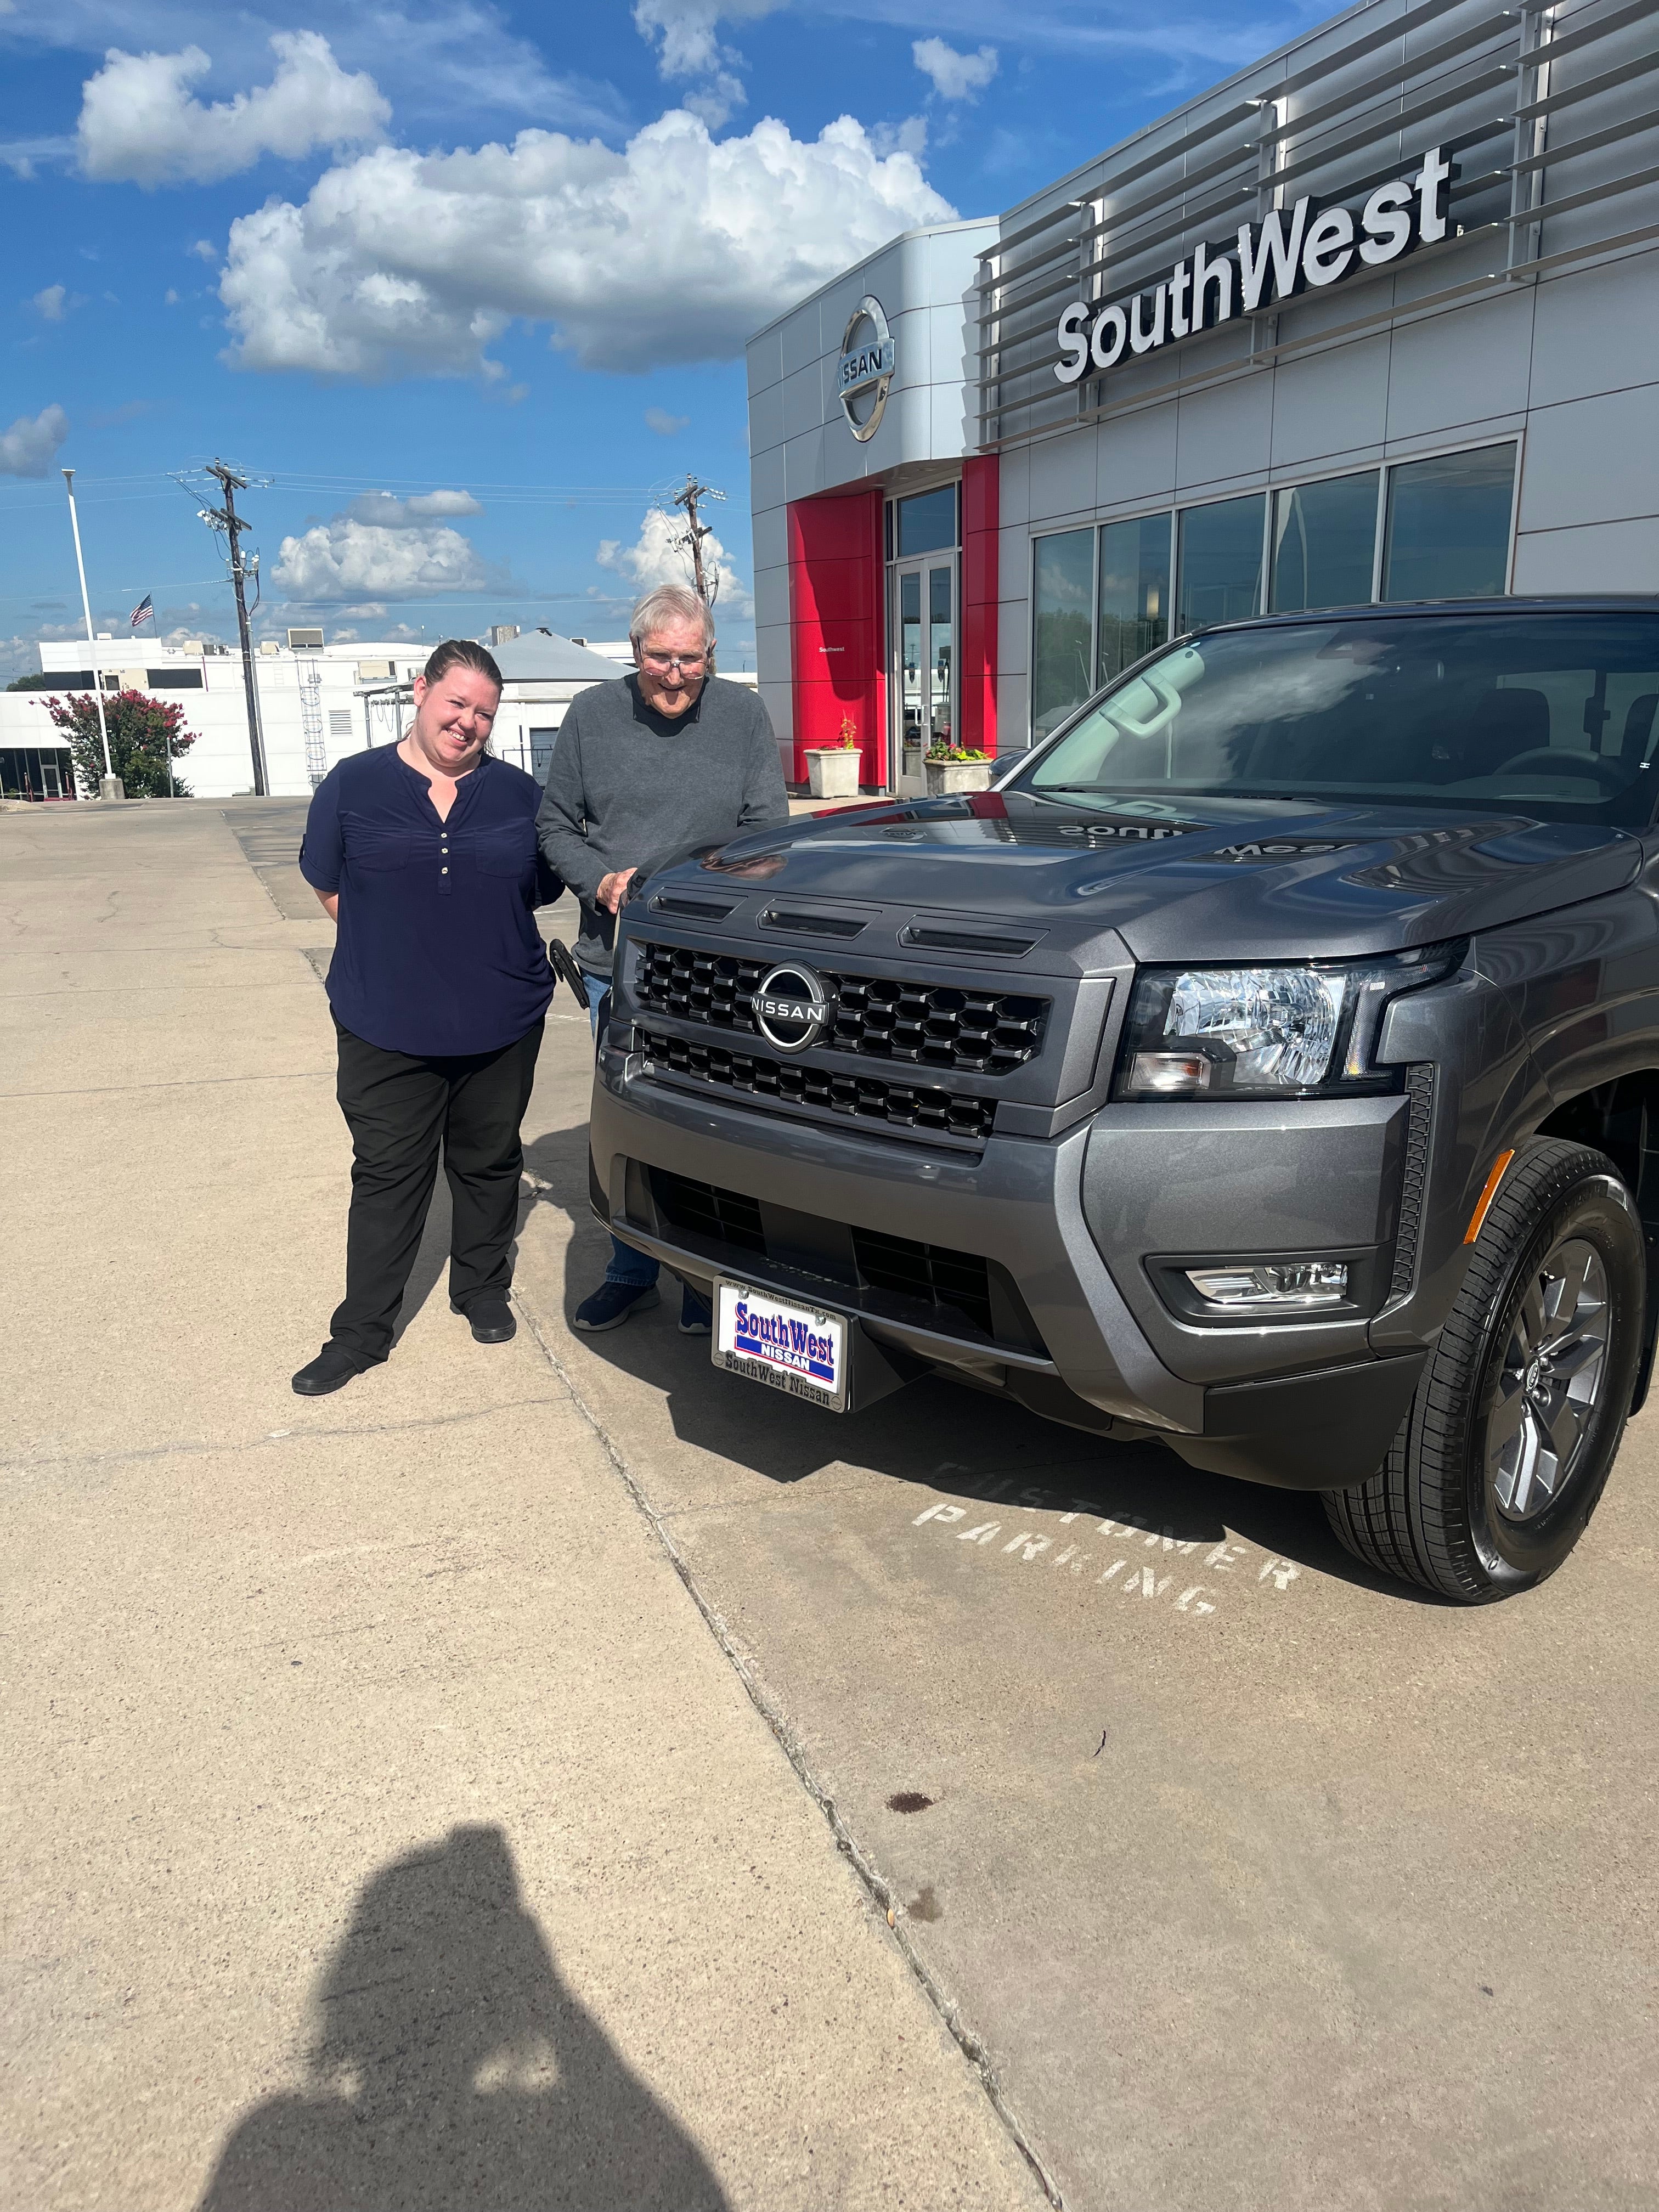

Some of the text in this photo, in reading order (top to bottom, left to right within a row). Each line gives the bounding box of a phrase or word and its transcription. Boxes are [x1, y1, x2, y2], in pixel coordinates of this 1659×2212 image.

[1053, 146, 1449, 384] SouthWest
[752, 997, 822, 1020] NISSAN
[735, 1301, 834, 1366] SouthWest
[760, 1343, 810, 1372] NISSAN
[725, 1352, 830, 1406] SouthWest Nissan
